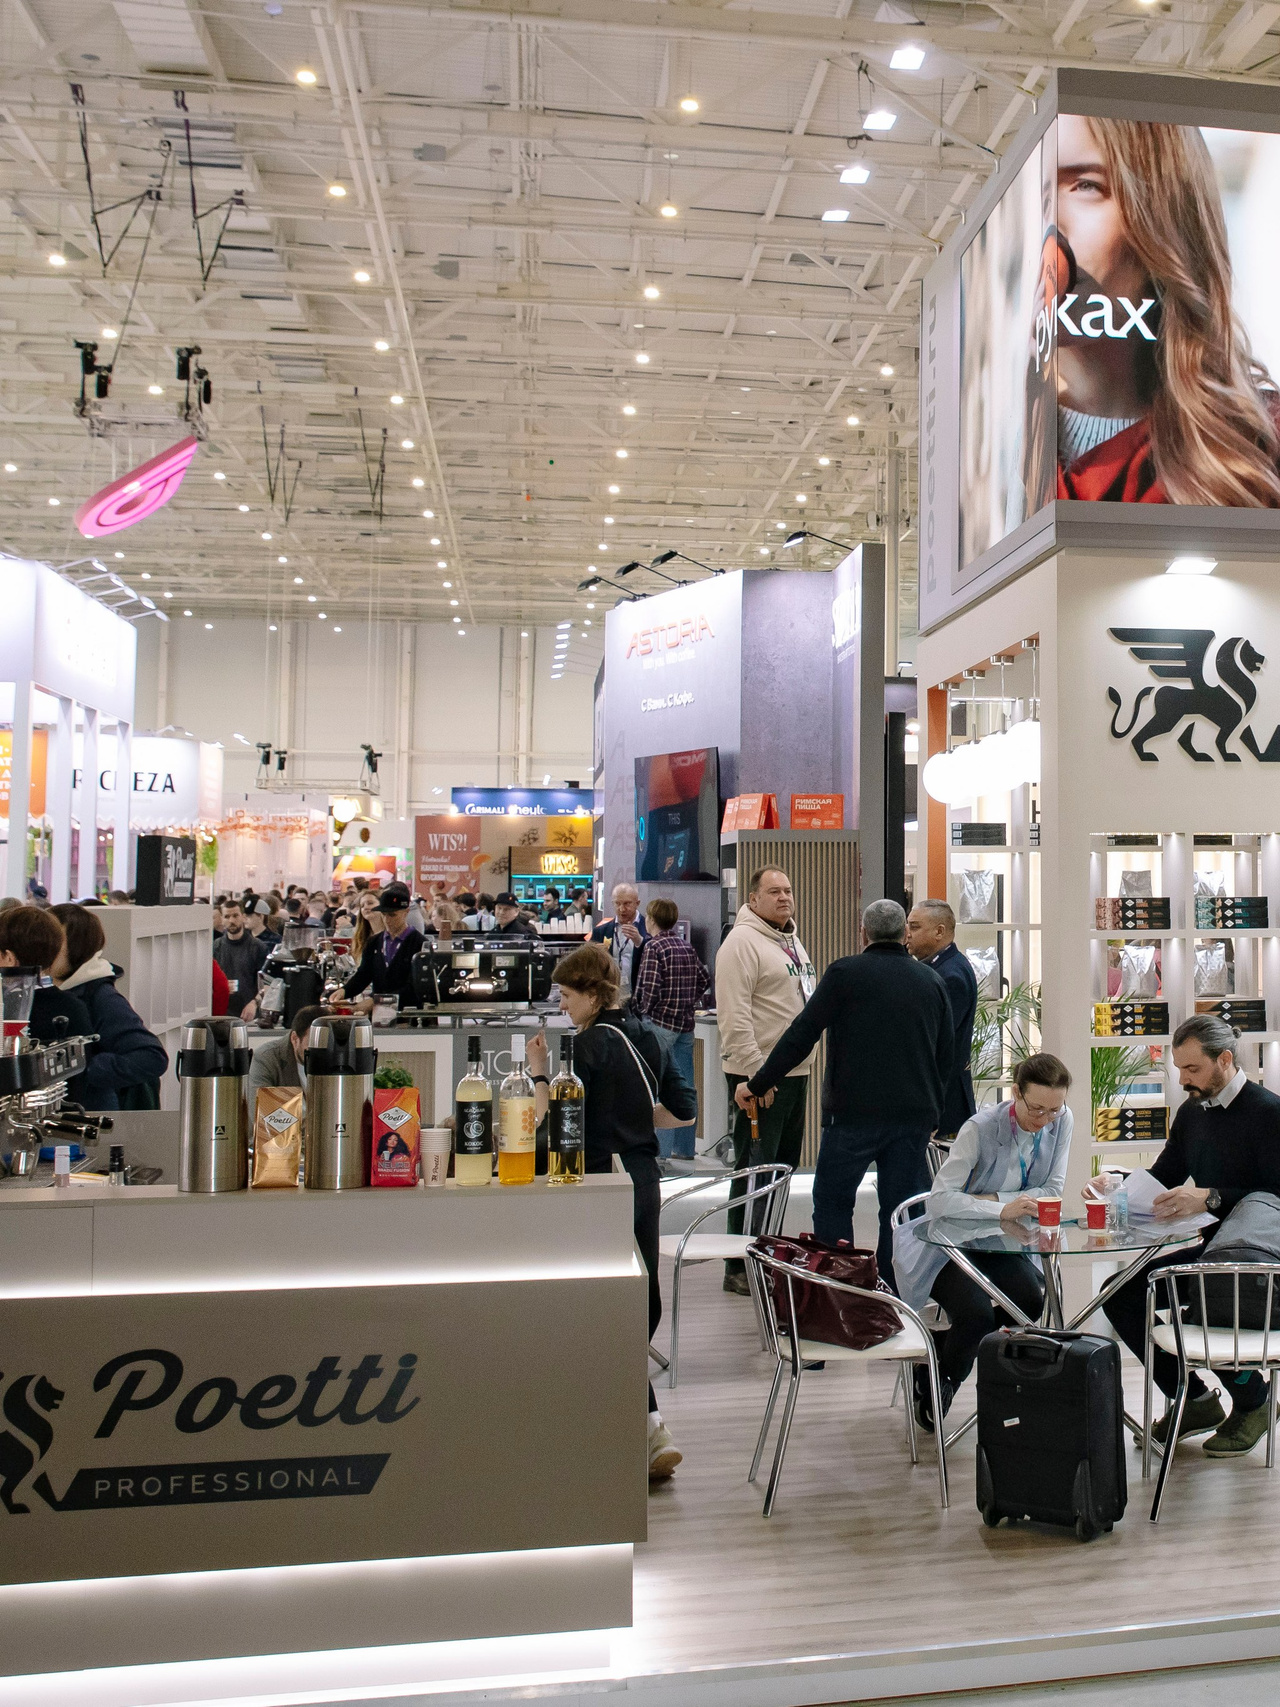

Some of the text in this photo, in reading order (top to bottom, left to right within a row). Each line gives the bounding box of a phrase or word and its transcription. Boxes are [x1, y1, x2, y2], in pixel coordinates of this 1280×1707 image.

[626, 615, 715, 659] ASTORIA
[668, 813, 681, 825] THIS
[428, 833, 467, 851] WTS?!
[541, 854, 580, 875] WTS?!
[268, 1115, 293, 1124] Poetti
[93, 1349, 421, 1439] Poetti
[95, 1467, 361, 1499] PROFESSIONAL
